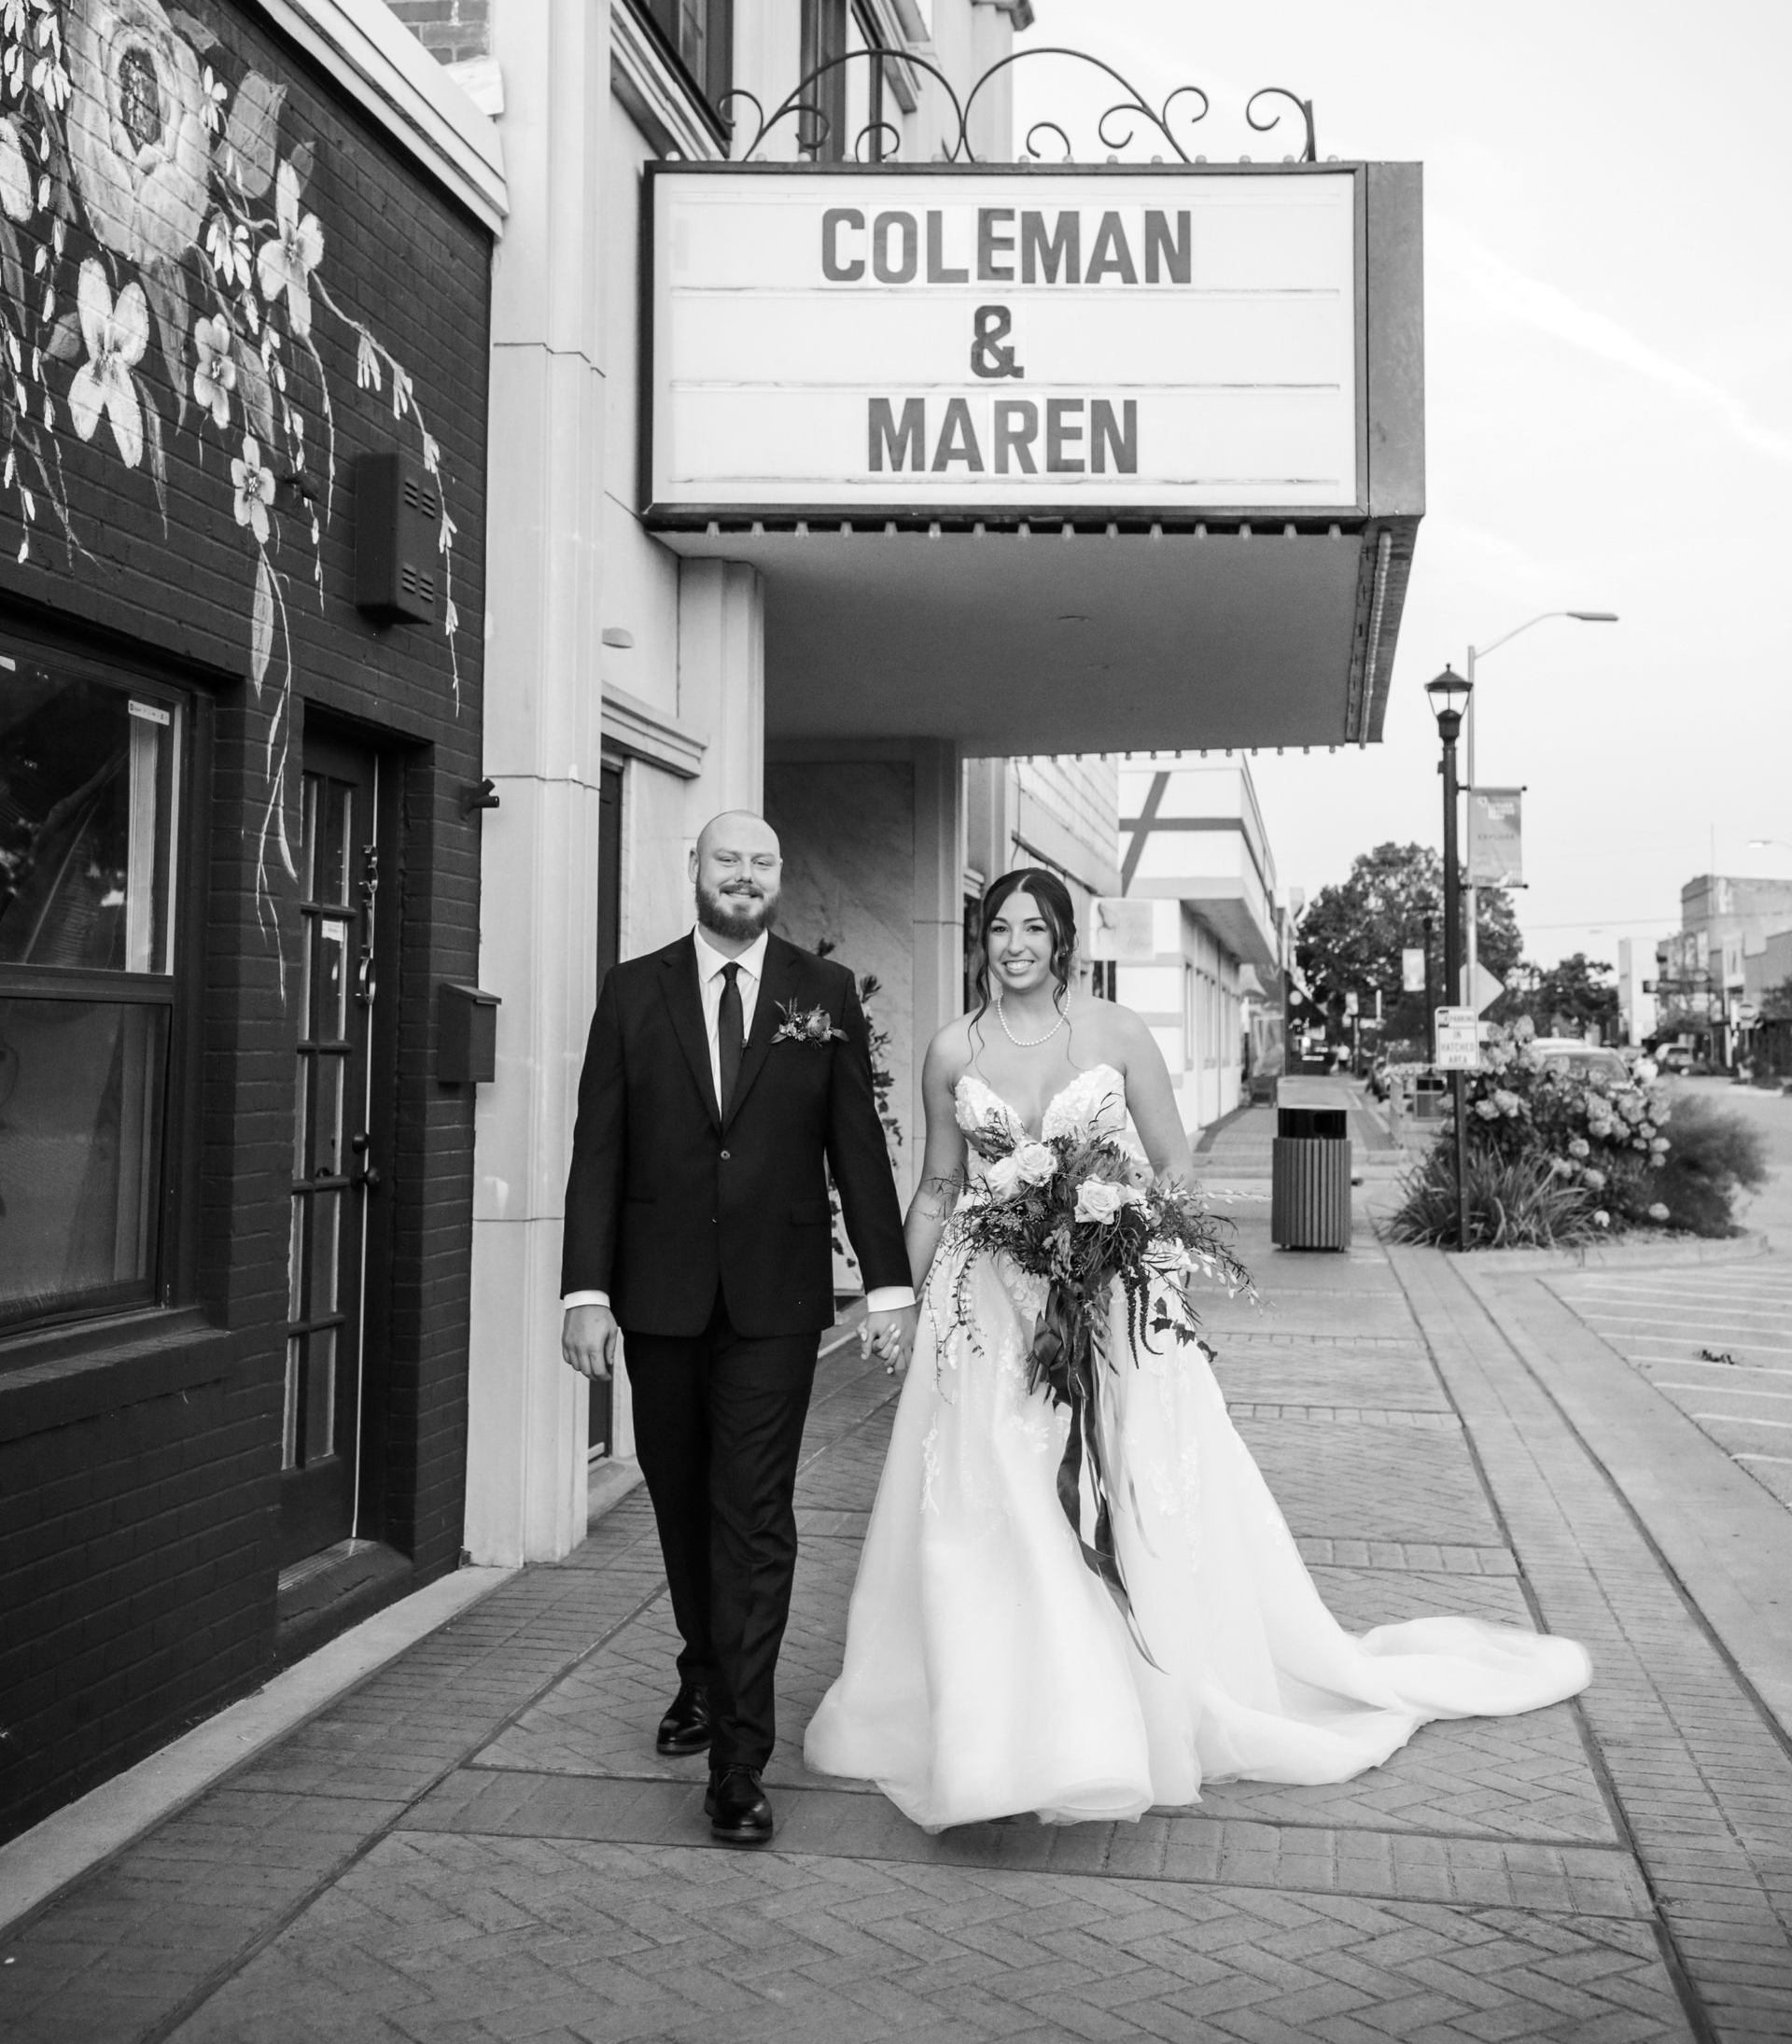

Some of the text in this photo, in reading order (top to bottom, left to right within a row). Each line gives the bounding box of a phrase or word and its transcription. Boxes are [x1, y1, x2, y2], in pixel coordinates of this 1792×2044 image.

[822, 208, 1191, 285] COLEMAN
[971, 305, 1024, 379] &
[868, 398, 1138, 474] MAREN
[1440, 1043, 1475, 1052] HATCHED
